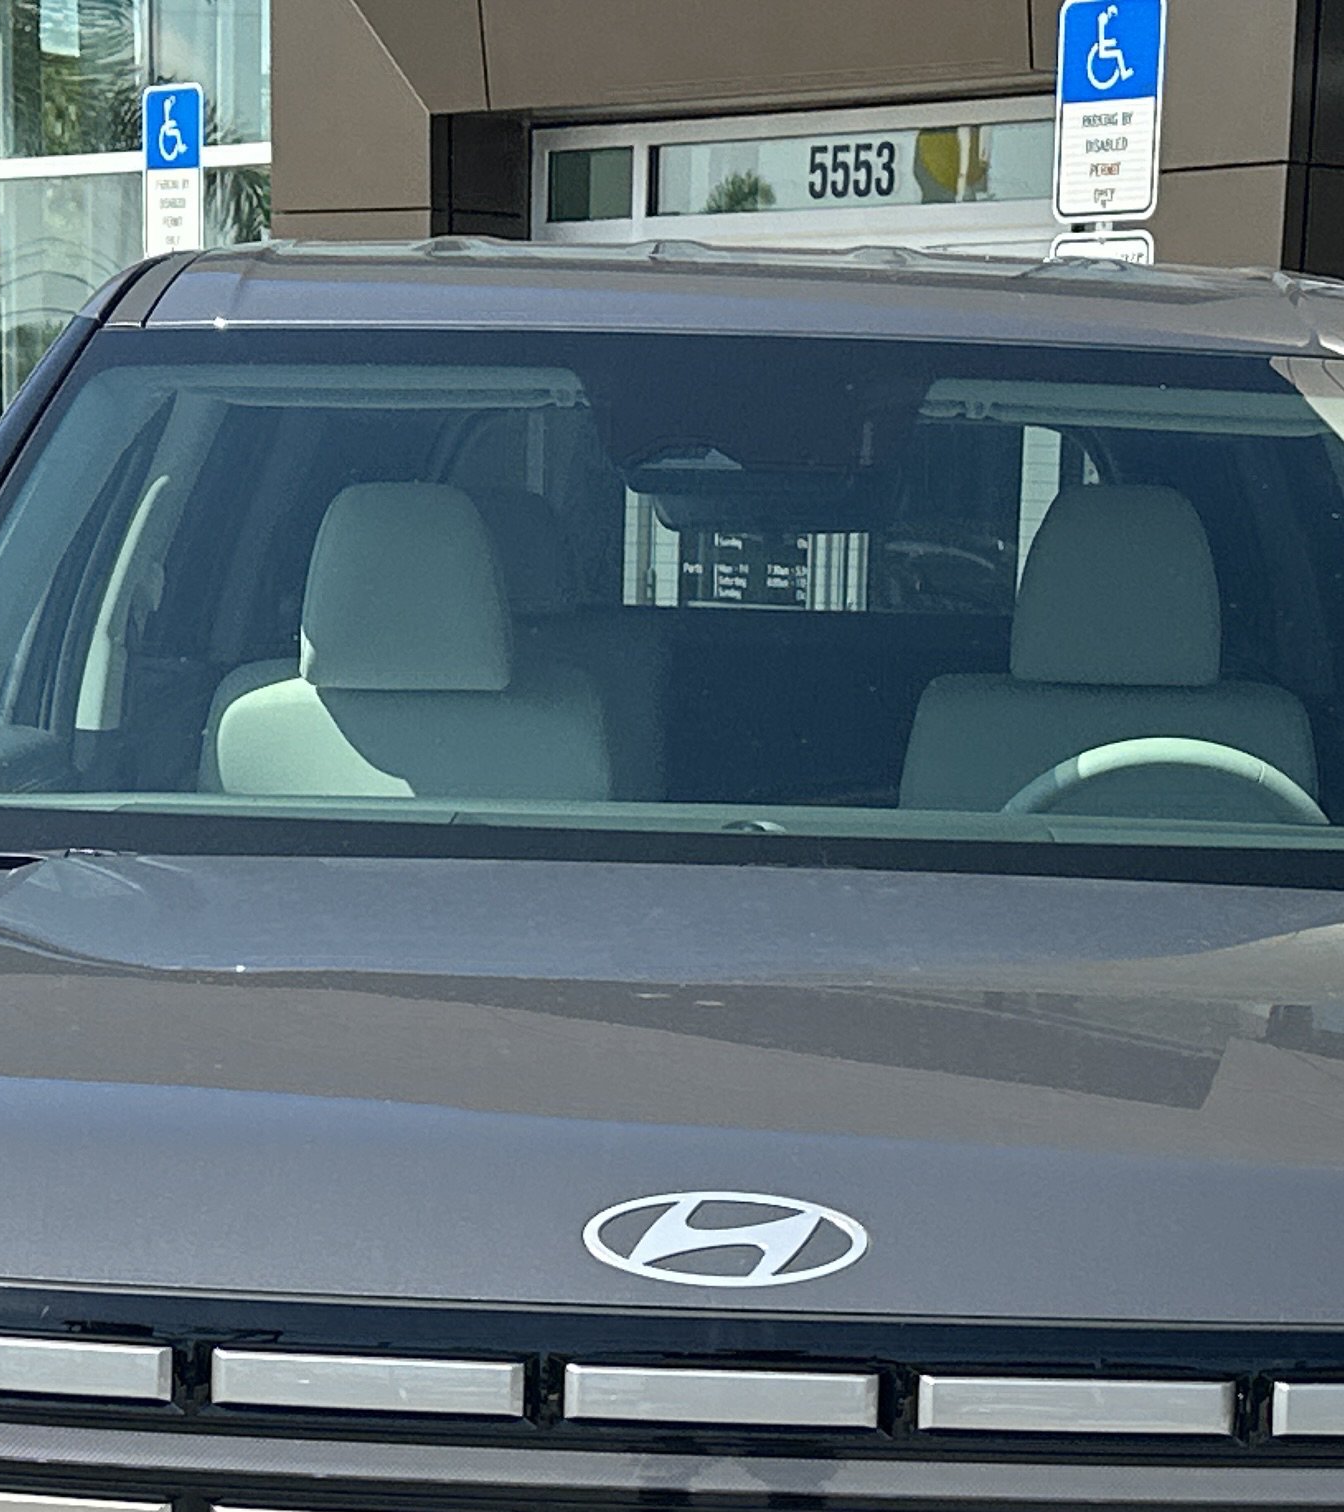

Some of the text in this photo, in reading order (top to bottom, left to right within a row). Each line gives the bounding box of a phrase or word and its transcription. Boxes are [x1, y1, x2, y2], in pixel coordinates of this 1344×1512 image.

[1121, 111, 1133, 126] BY
[1085, 136, 1128, 154] DISABLED
[808, 141, 895, 200] 5553
